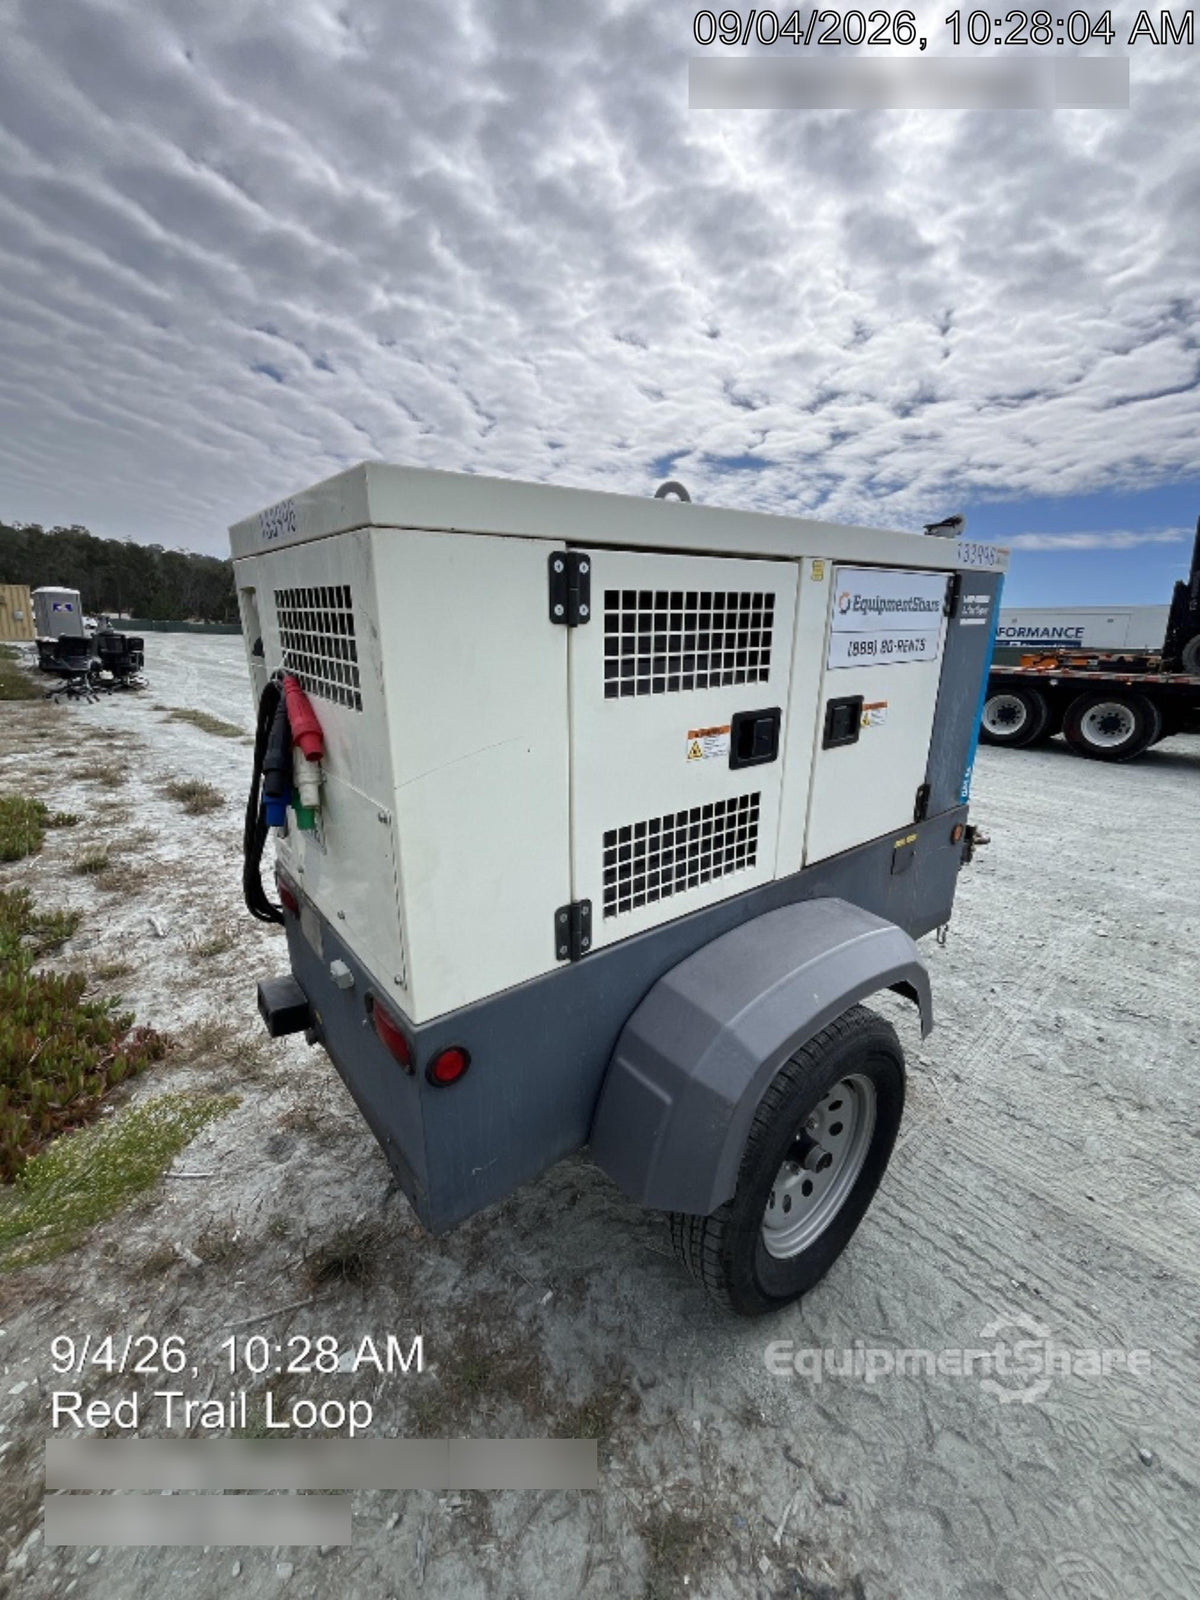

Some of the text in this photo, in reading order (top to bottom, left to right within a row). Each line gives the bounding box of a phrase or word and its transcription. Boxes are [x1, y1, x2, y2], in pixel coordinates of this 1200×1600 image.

[852, 594, 940, 616] EquipmentShare
[996, 626, 1085, 639] FORMANCE
[847, 640, 878, 658] (888)
